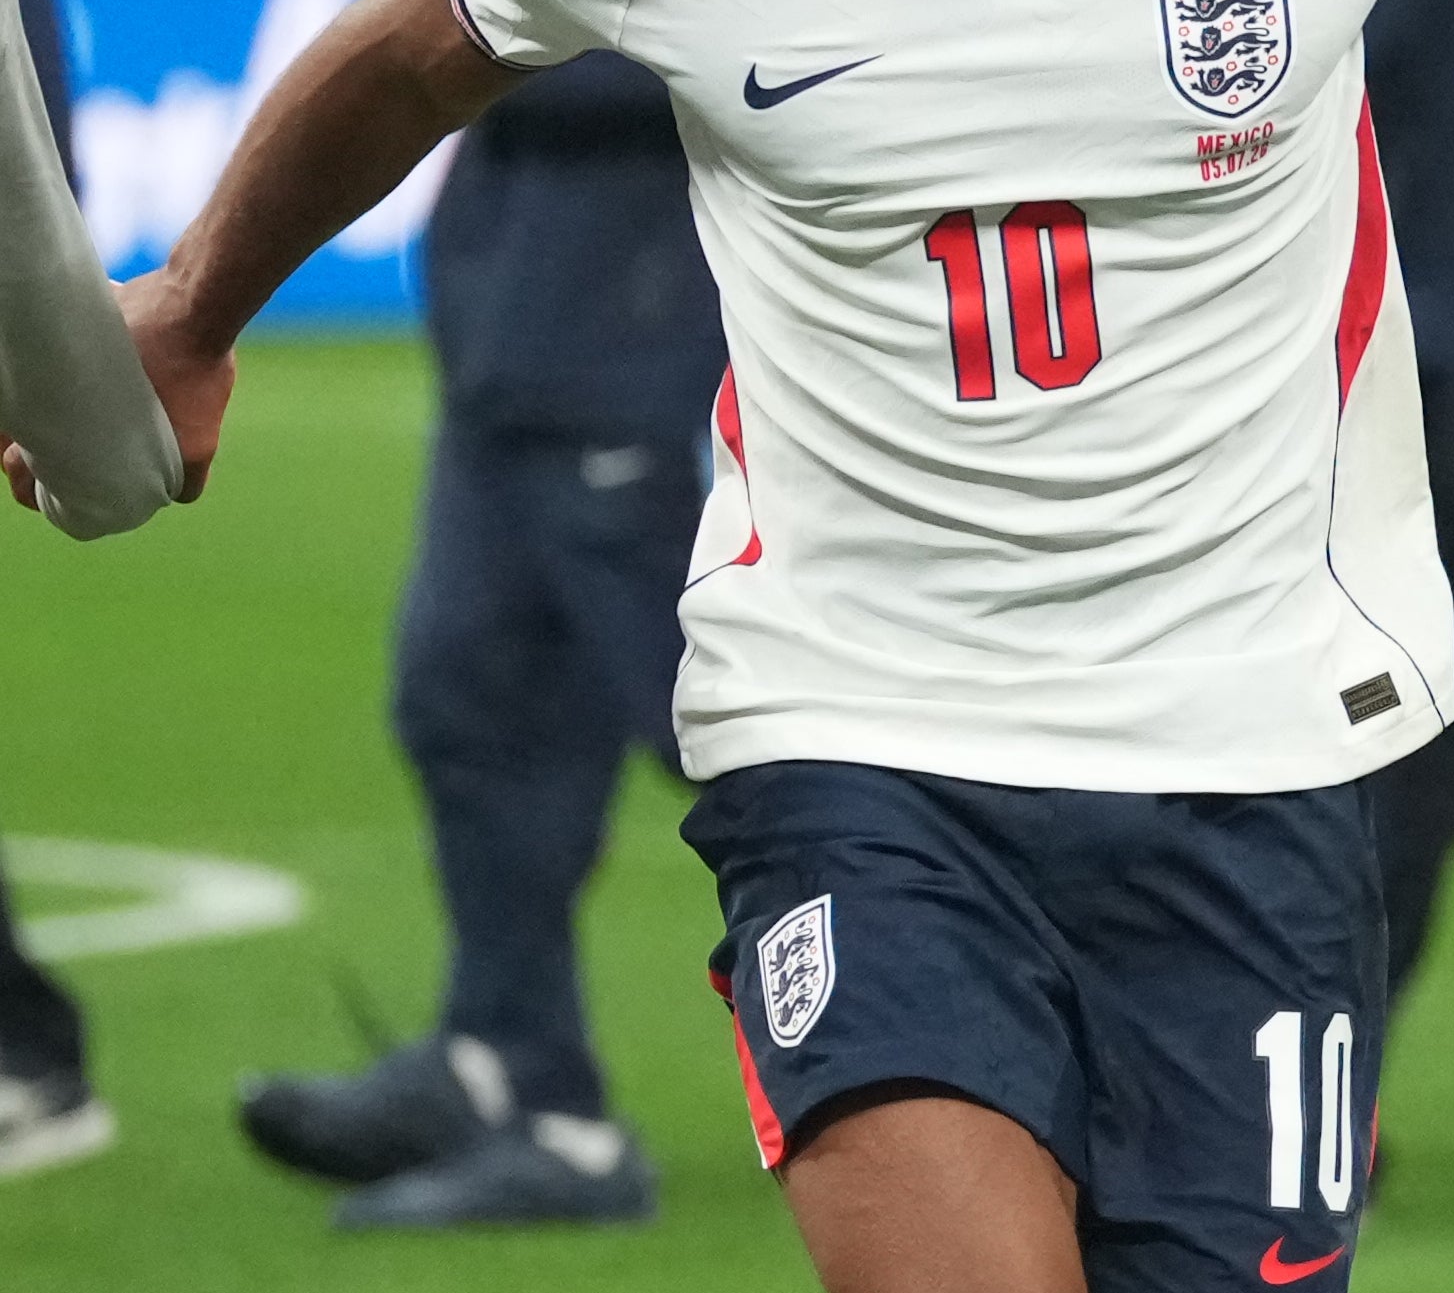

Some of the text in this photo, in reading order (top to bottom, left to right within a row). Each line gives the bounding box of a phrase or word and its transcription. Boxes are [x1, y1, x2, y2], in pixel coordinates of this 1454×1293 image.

[1197, 121, 1274, 157] MEXICO
[924, 200, 1102, 402] 10
[1252, 1011, 1355, 1213] 10
